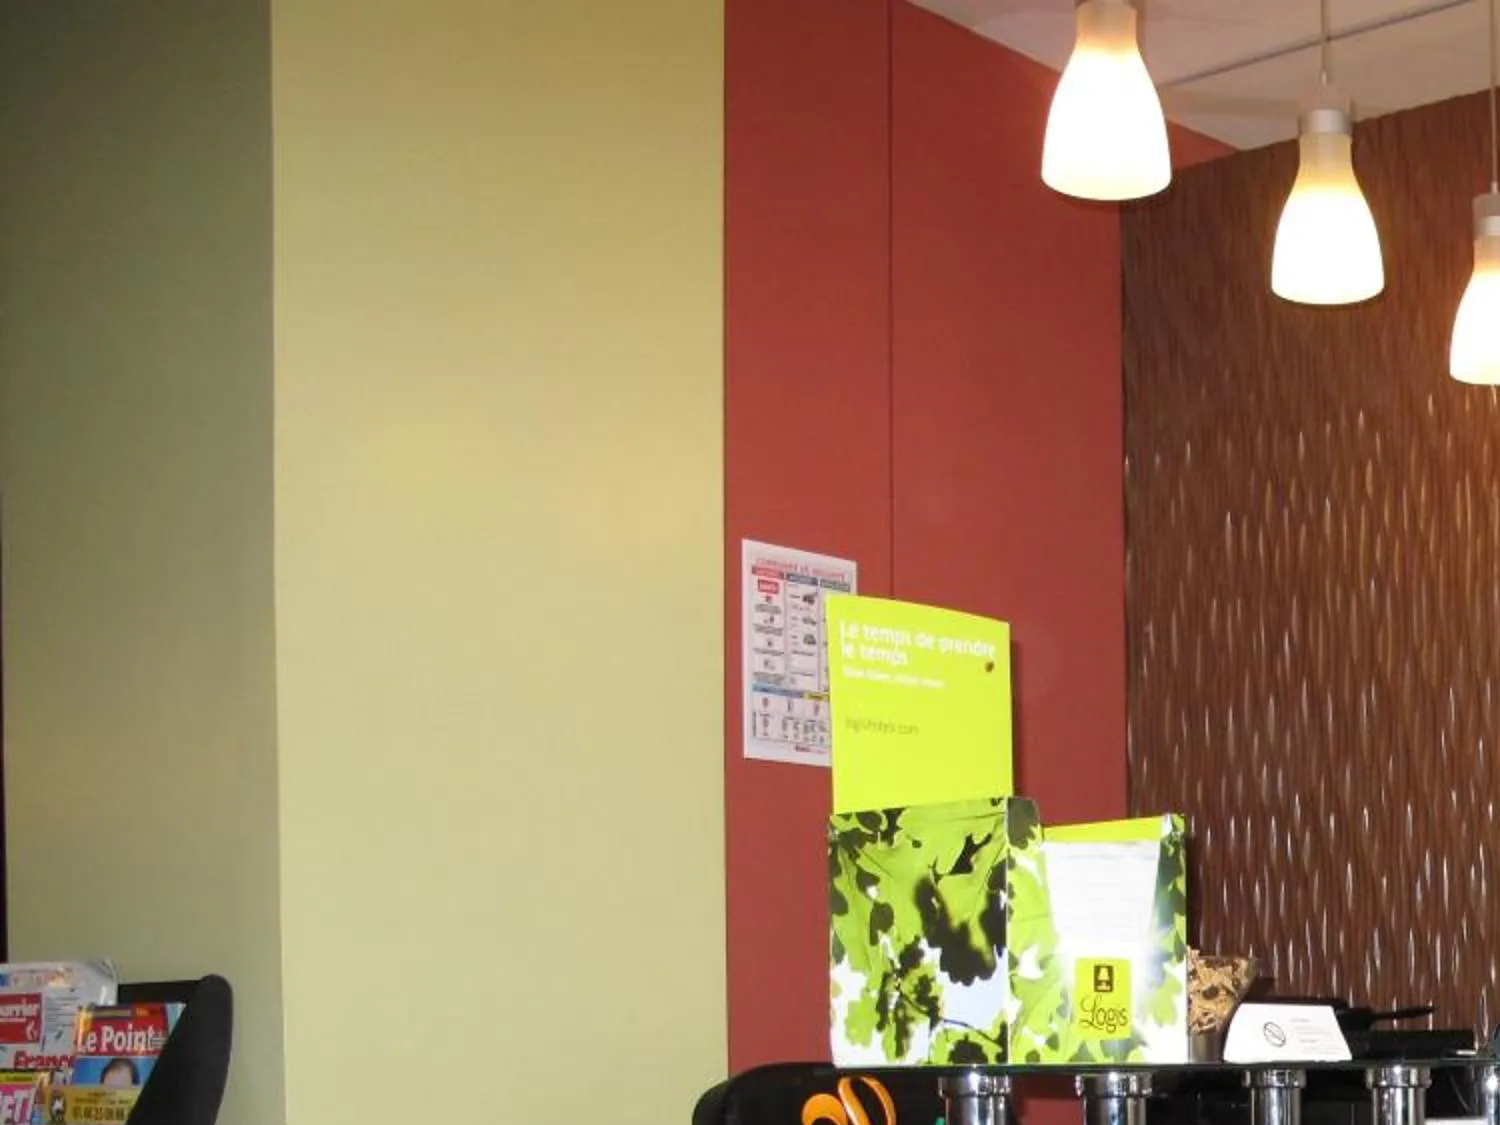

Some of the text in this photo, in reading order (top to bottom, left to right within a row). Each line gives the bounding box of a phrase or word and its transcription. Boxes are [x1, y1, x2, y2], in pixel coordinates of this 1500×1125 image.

[840, 620, 995, 658] Le temps de prendre
[841, 639, 908, 667] le temps
[1079, 994, 1129, 1034] Logis
[77, 1023, 156, 1053] Le Point
